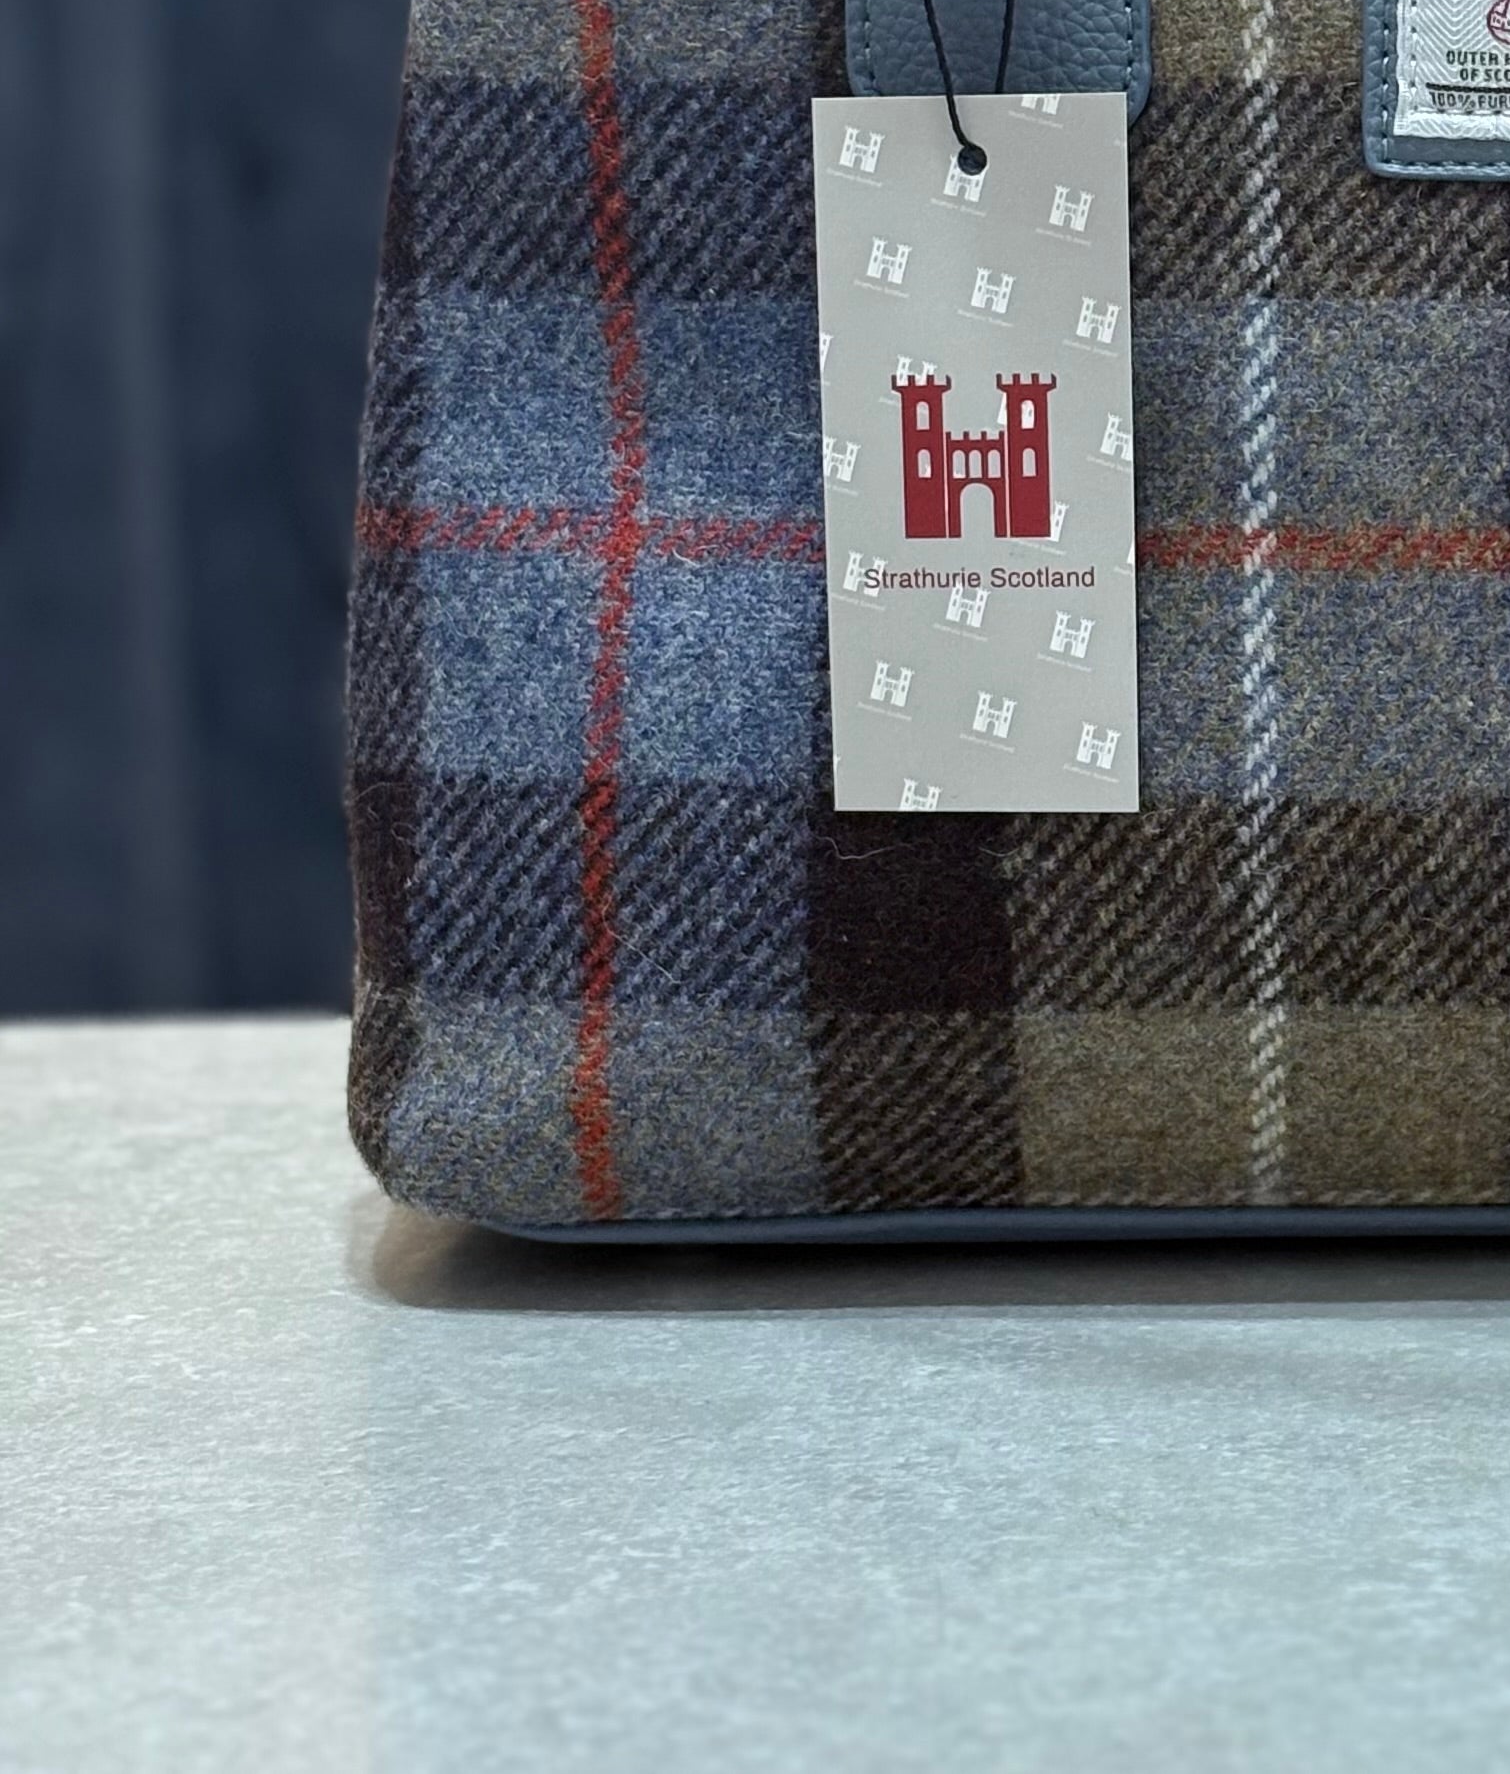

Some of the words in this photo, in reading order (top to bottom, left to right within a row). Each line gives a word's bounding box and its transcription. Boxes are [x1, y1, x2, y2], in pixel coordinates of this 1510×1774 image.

[1446, 50, 1499, 66] OUTER
[1459, 68, 1479, 81] OF
[1429, 91, 1476, 110] 100%
[864, 566, 982, 589] Strathurie
[991, 566, 1095, 588] Scotland
